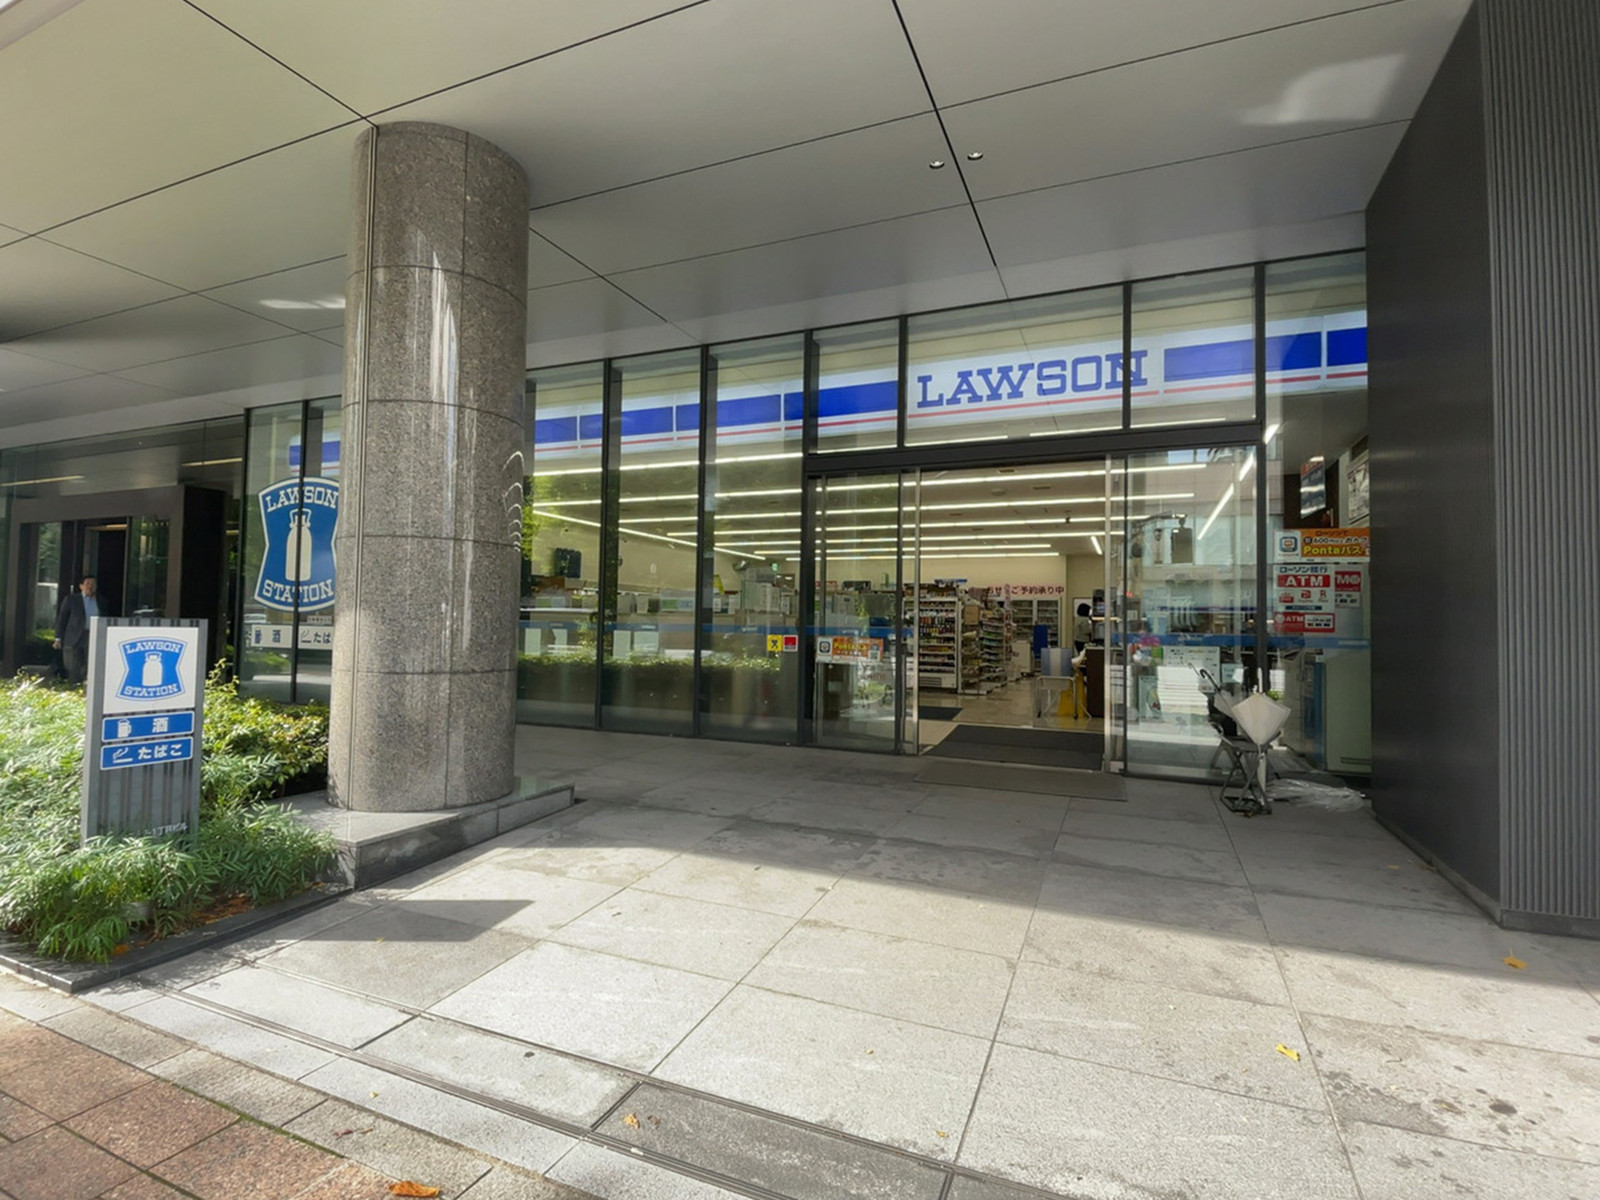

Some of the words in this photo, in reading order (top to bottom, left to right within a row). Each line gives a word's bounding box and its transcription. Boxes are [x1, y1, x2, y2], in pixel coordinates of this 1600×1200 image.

[917, 350, 1148, 408] LAWSON
[265, 485, 339, 513] LAWSON
[1285, 575, 1324, 587] ATM
[313, 632, 331, 644] たば
[125, 641, 181, 654] LAWSON
[123, 683, 178, 697] STATION
[152, 717, 169, 733] 酒
[138, 744, 182, 760] たばこ
